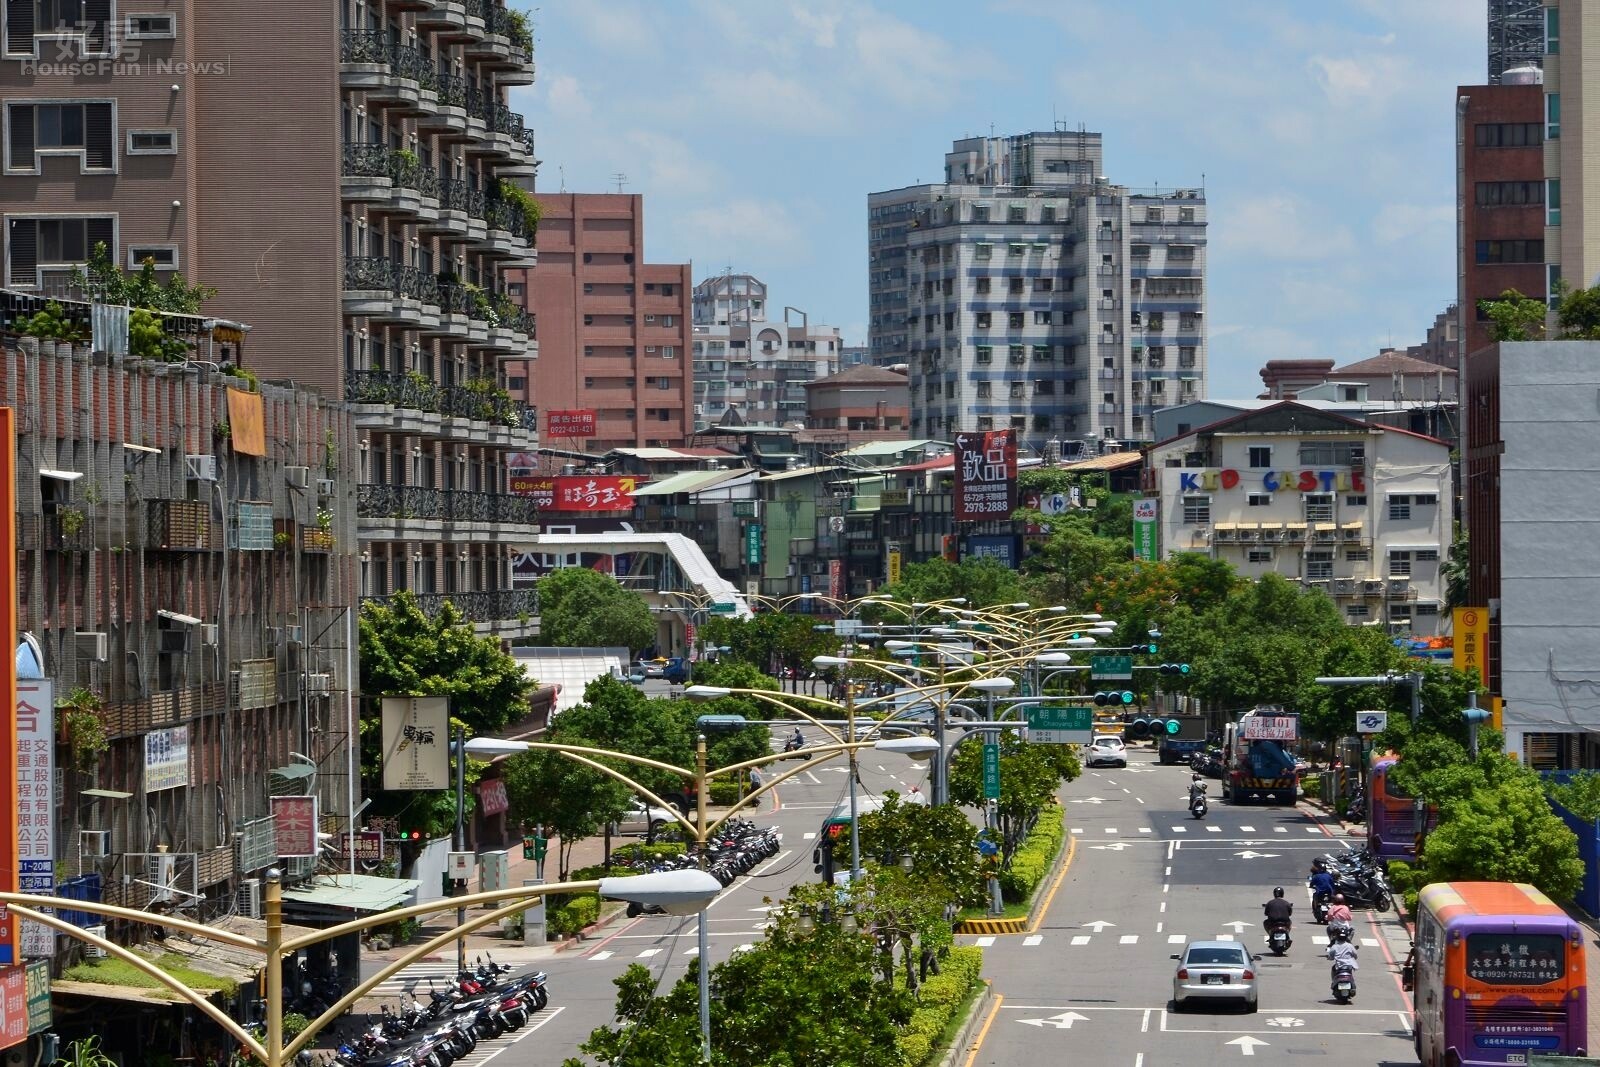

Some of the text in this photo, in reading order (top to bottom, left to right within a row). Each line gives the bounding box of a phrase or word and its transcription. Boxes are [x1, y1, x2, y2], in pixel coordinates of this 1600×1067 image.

[551, 414, 592, 423] 廣告出租
[1180, 469, 1366, 493] KID CASTLE
[964, 501, 1008, 513] 2978-2888
[974, 545, 1009, 559] 廣告出租
[1039, 709, 1086, 720] 朝陽街
[34, 739, 49, 857] 交通股份有限公司
